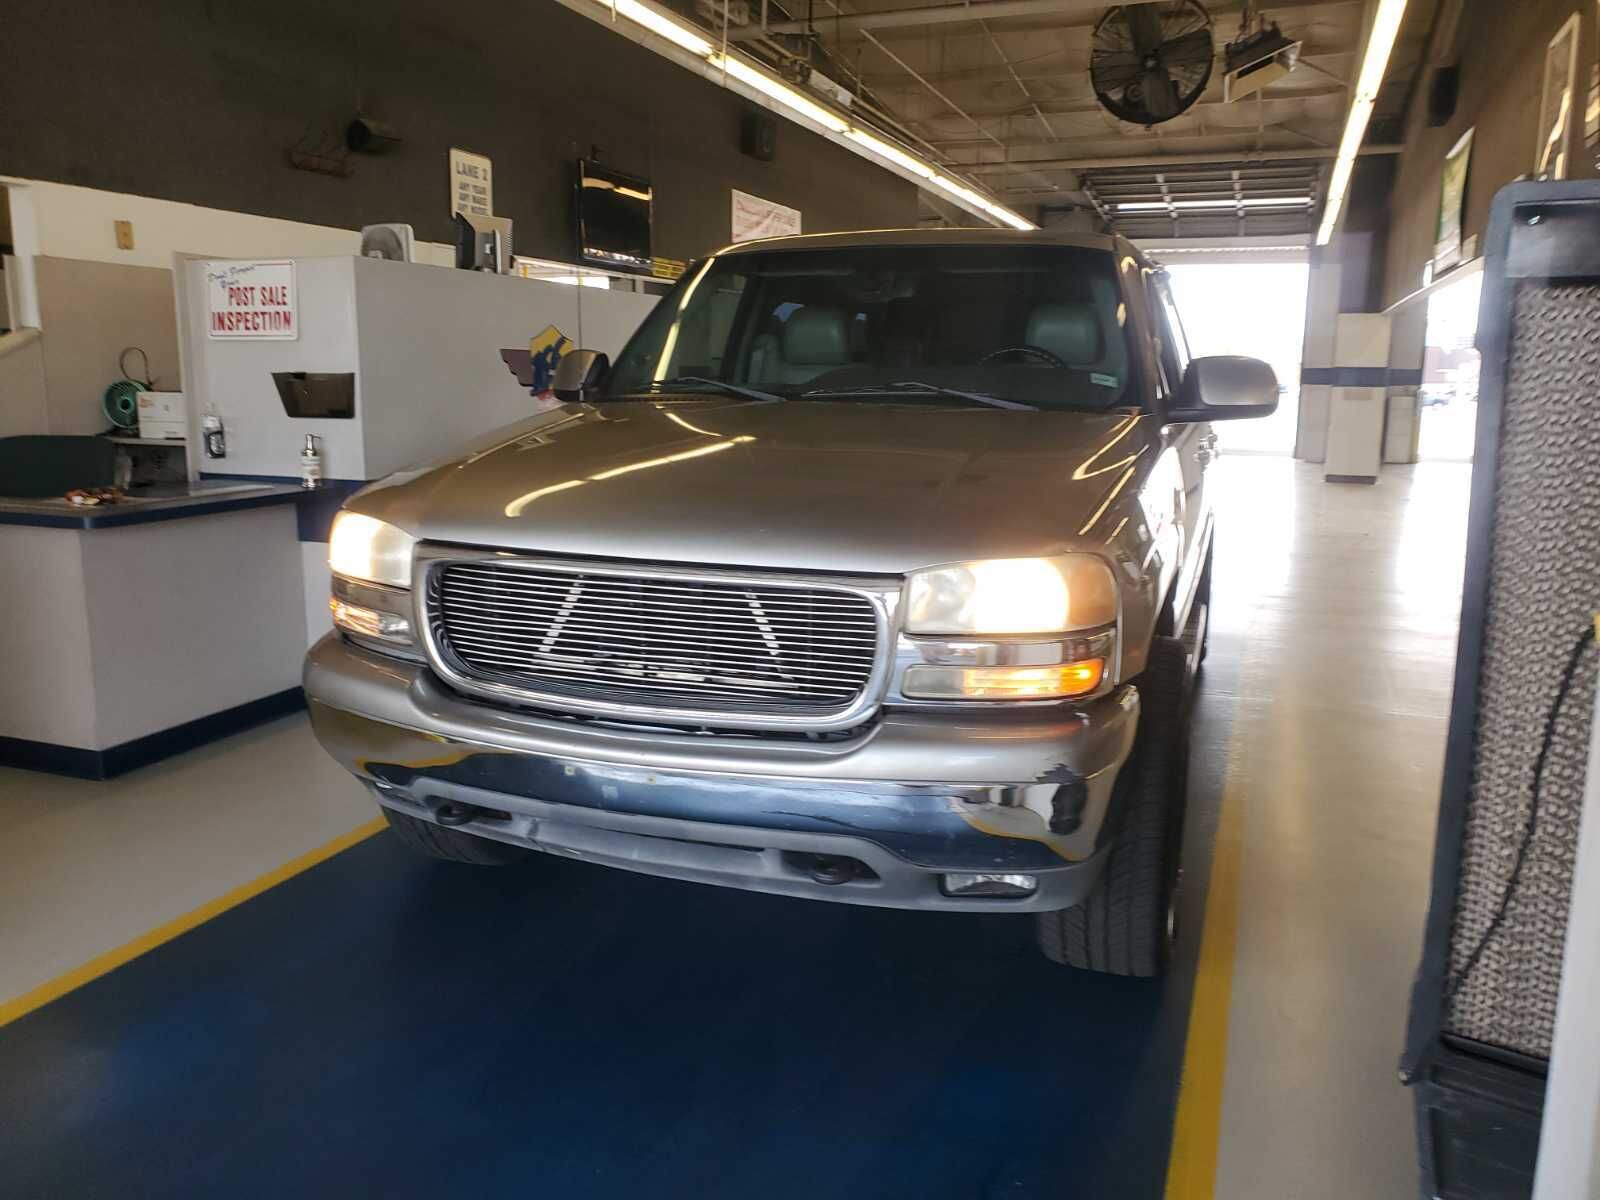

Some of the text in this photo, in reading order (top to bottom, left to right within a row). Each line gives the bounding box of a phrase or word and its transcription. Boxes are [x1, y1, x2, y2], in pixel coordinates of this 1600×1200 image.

[456, 161, 479, 179] LANE
[228, 286, 288, 306] POST SALE
[212, 311, 292, 331] INSPECTION
